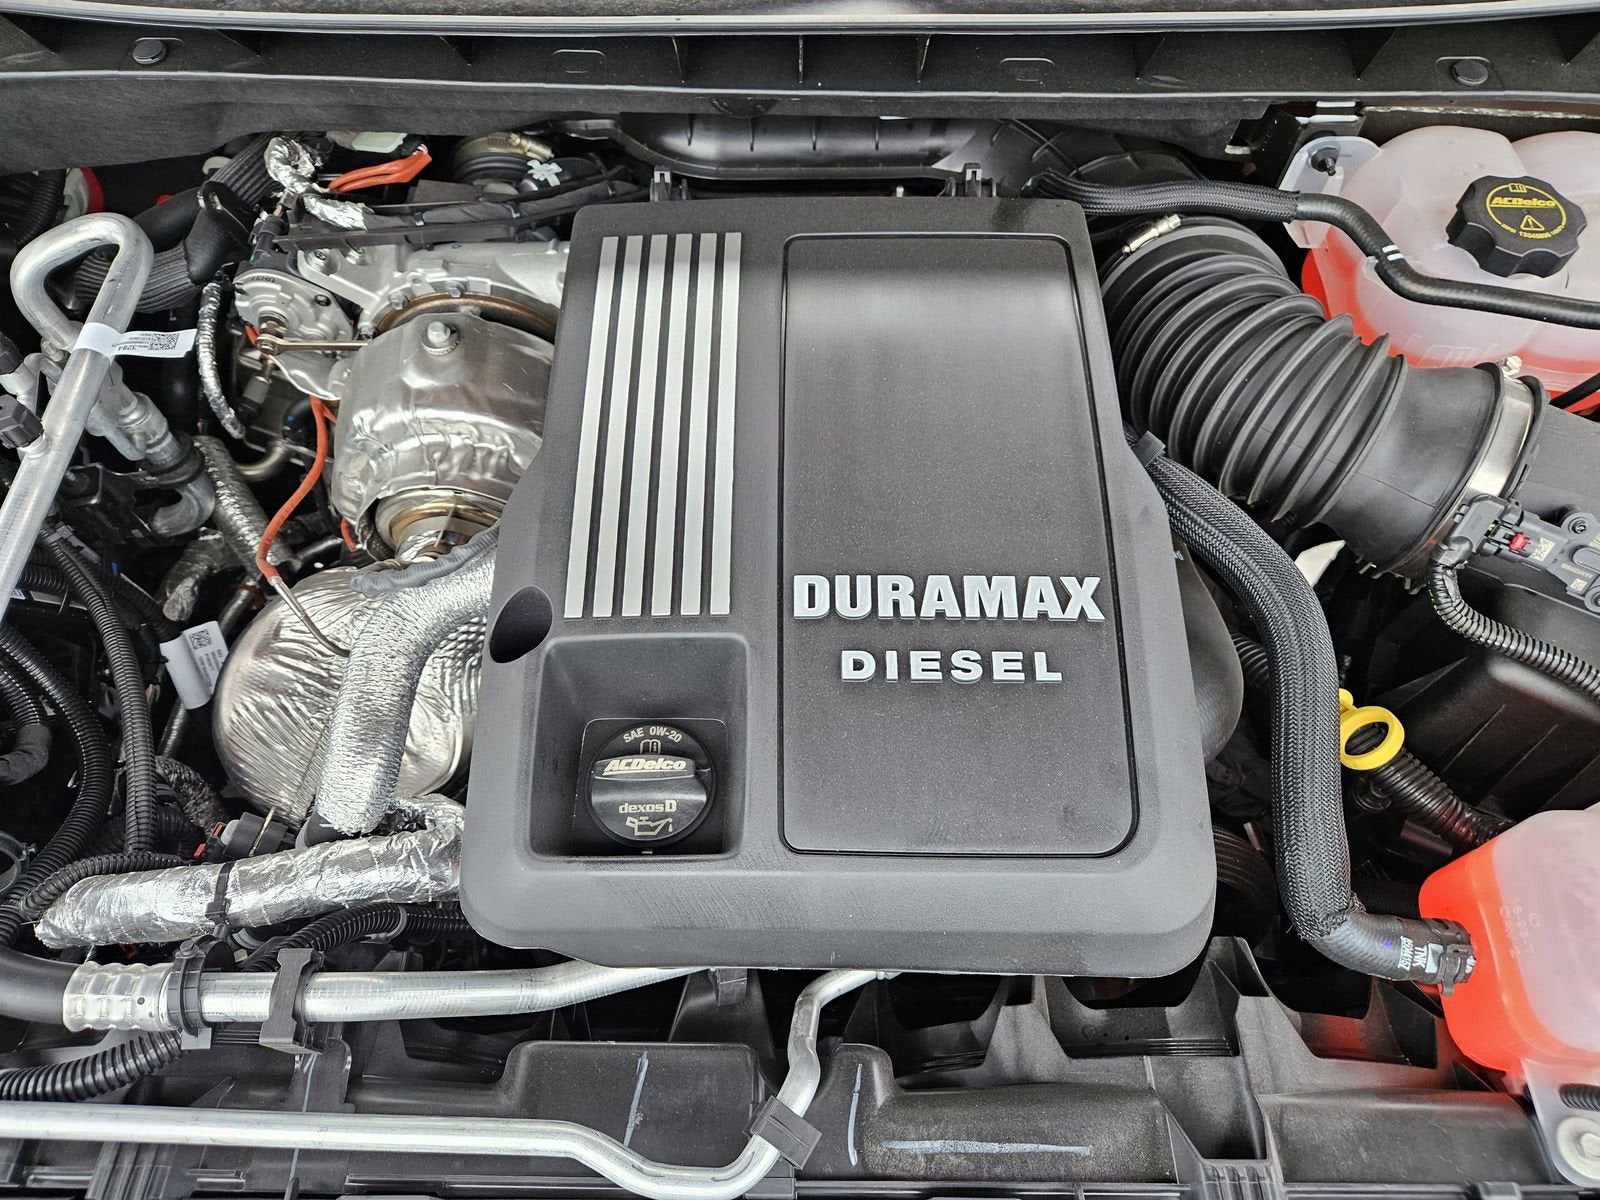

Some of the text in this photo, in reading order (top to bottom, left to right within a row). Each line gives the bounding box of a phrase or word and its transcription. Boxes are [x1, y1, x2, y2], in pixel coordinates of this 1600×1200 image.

[1491, 196, 1556, 207] ACDelco
[793, 575, 1105, 621] DURAMAX
[841, 650, 1063, 683] DIESEL
[623, 726, 682, 743] SAE 0W-20
[603, 758, 687, 772] ACDelco
[1412, 945, 1428, 969] TNK
